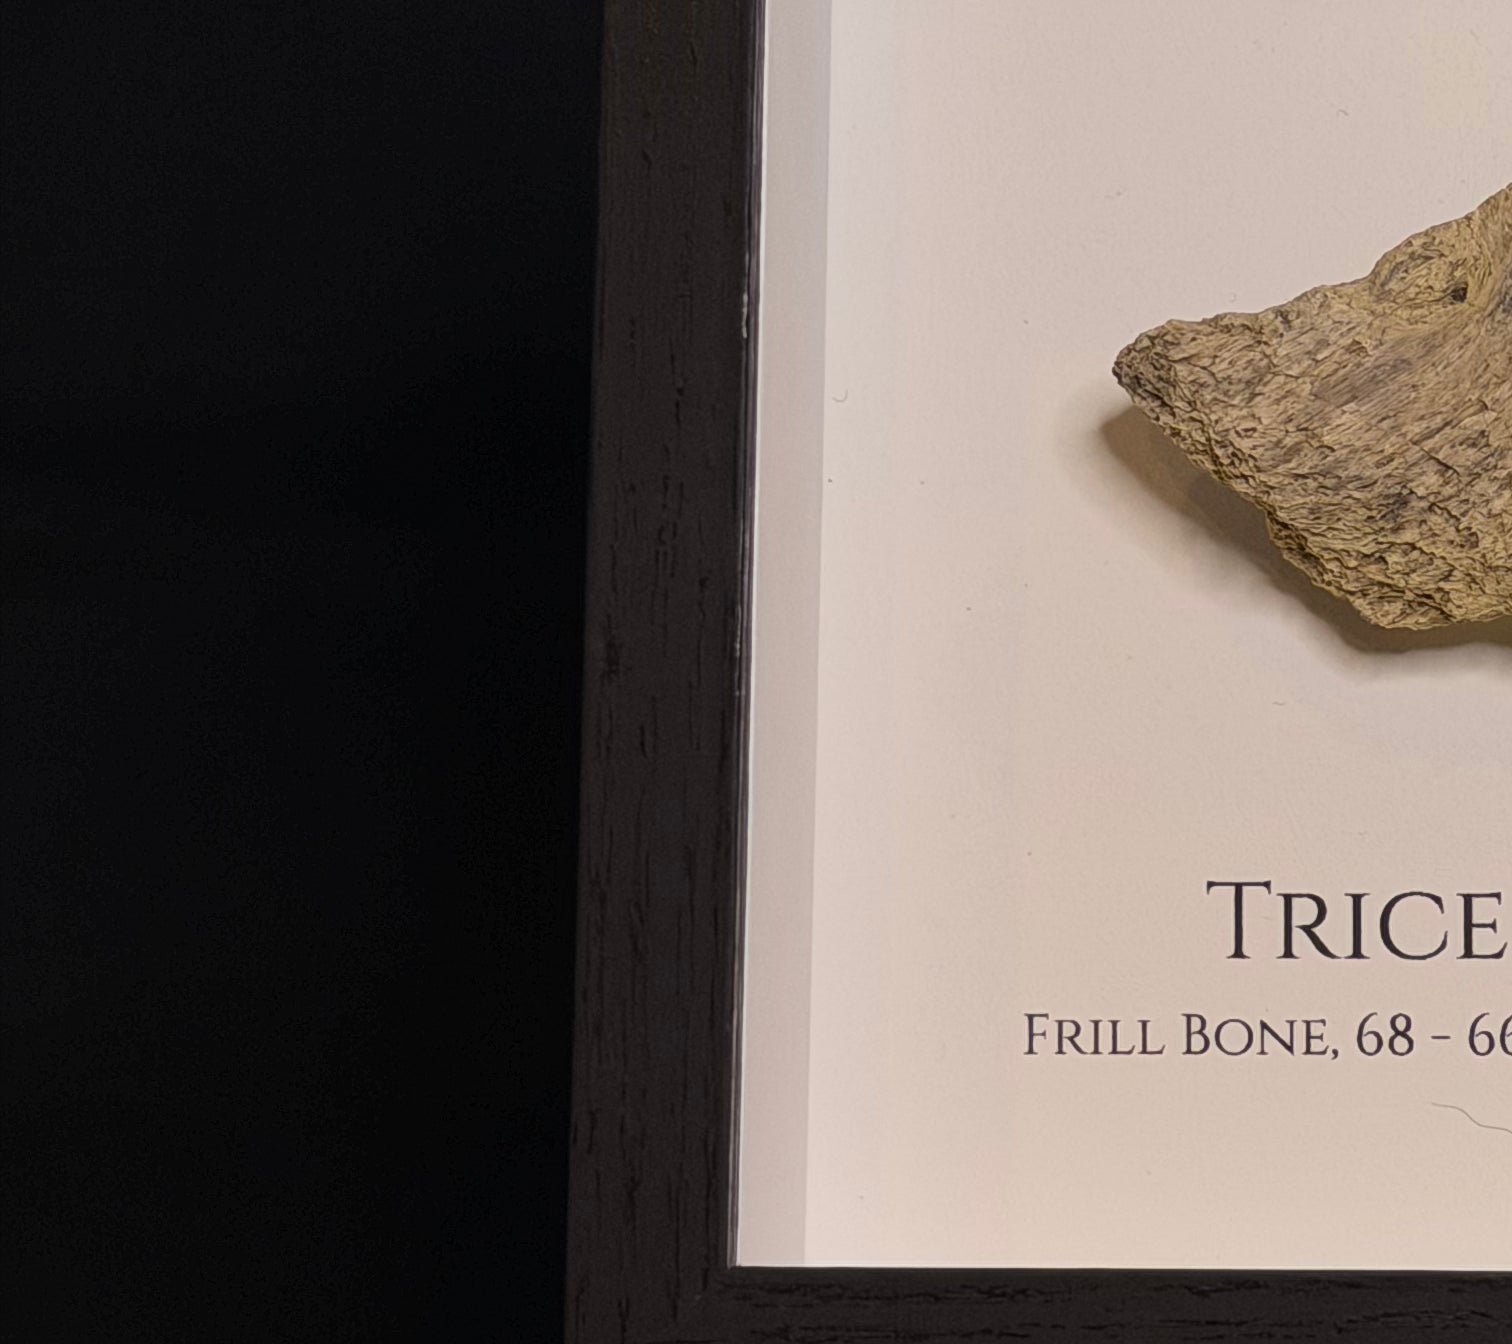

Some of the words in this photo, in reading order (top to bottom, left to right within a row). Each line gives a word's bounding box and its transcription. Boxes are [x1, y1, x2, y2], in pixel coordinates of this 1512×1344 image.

[1023, 1012, 1166, 1056] FRILL
[1180, 1012, 1340, 1061] BONE,
[1356, 1011, 1415, 1057] 68
